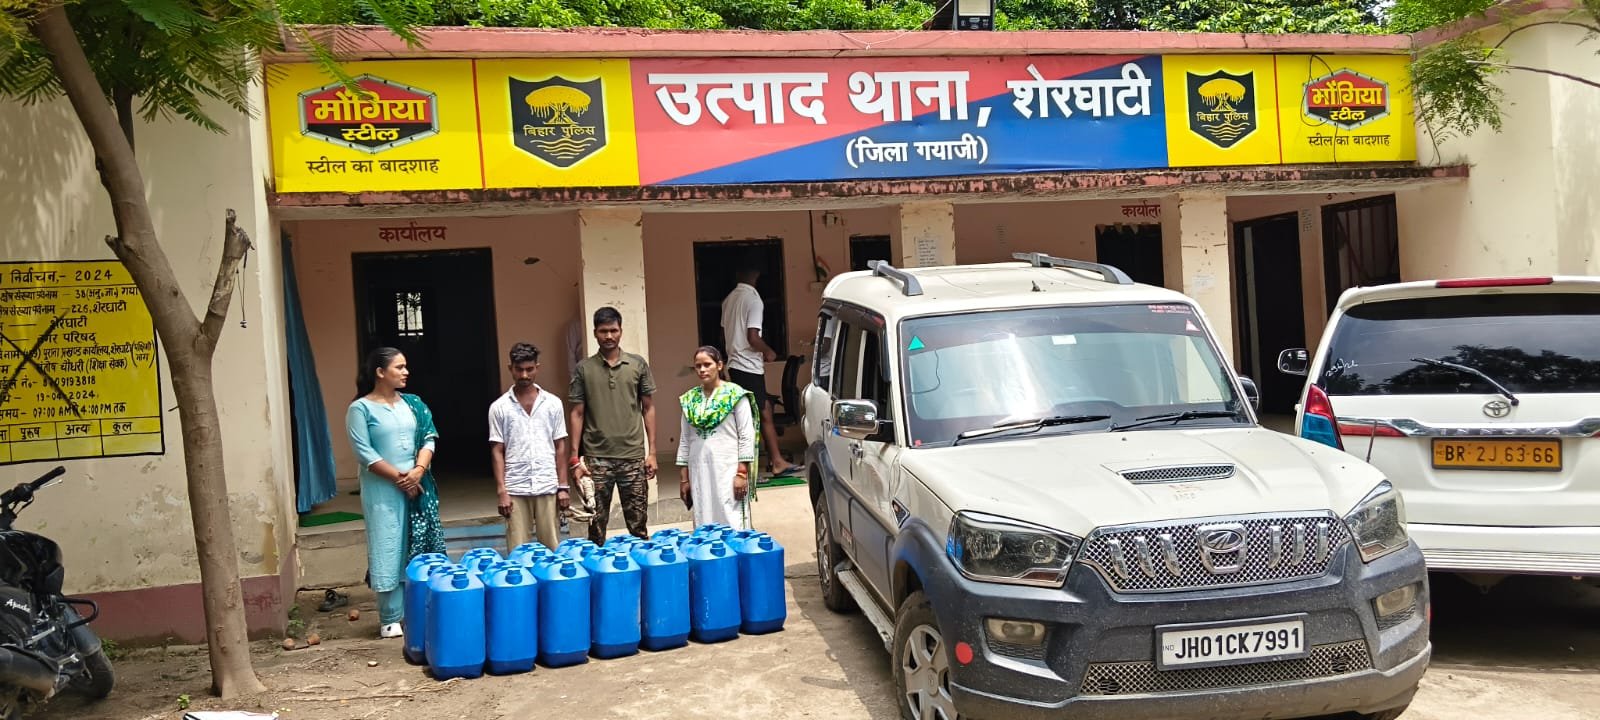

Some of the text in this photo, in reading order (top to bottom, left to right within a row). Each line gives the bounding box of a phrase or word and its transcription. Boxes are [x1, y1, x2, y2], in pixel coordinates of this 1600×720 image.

[649, 62, 1152, 127] उत्पाद थाना, शेरघाटी
[1312, 79, 1383, 105] मोंगिया
[1196, 111, 1249, 124] बिहार पुलिस
[1329, 106, 1367, 120] स्टील
[341, 123, 400, 141] स्टील
[523, 124, 596, 139] बिहार पुलिस
[1308, 133, 1391, 146] स्टील का बादशाह
[846, 135, 989, 168] (जिला गयाजी)
[306, 155, 440, 174] स्टील का बादशाह
[1121, 200, 1161, 218] कार्याल
[379, 221, 447, 242] कार्यालय
[75, 269, 112, 282] 2024
[33, 407, 55, 418] 07:00
[113, 402, 126, 413] तक
[112, 422, 132, 436] कुल
[1175, 627, 1299, 659] JH01CK7991
